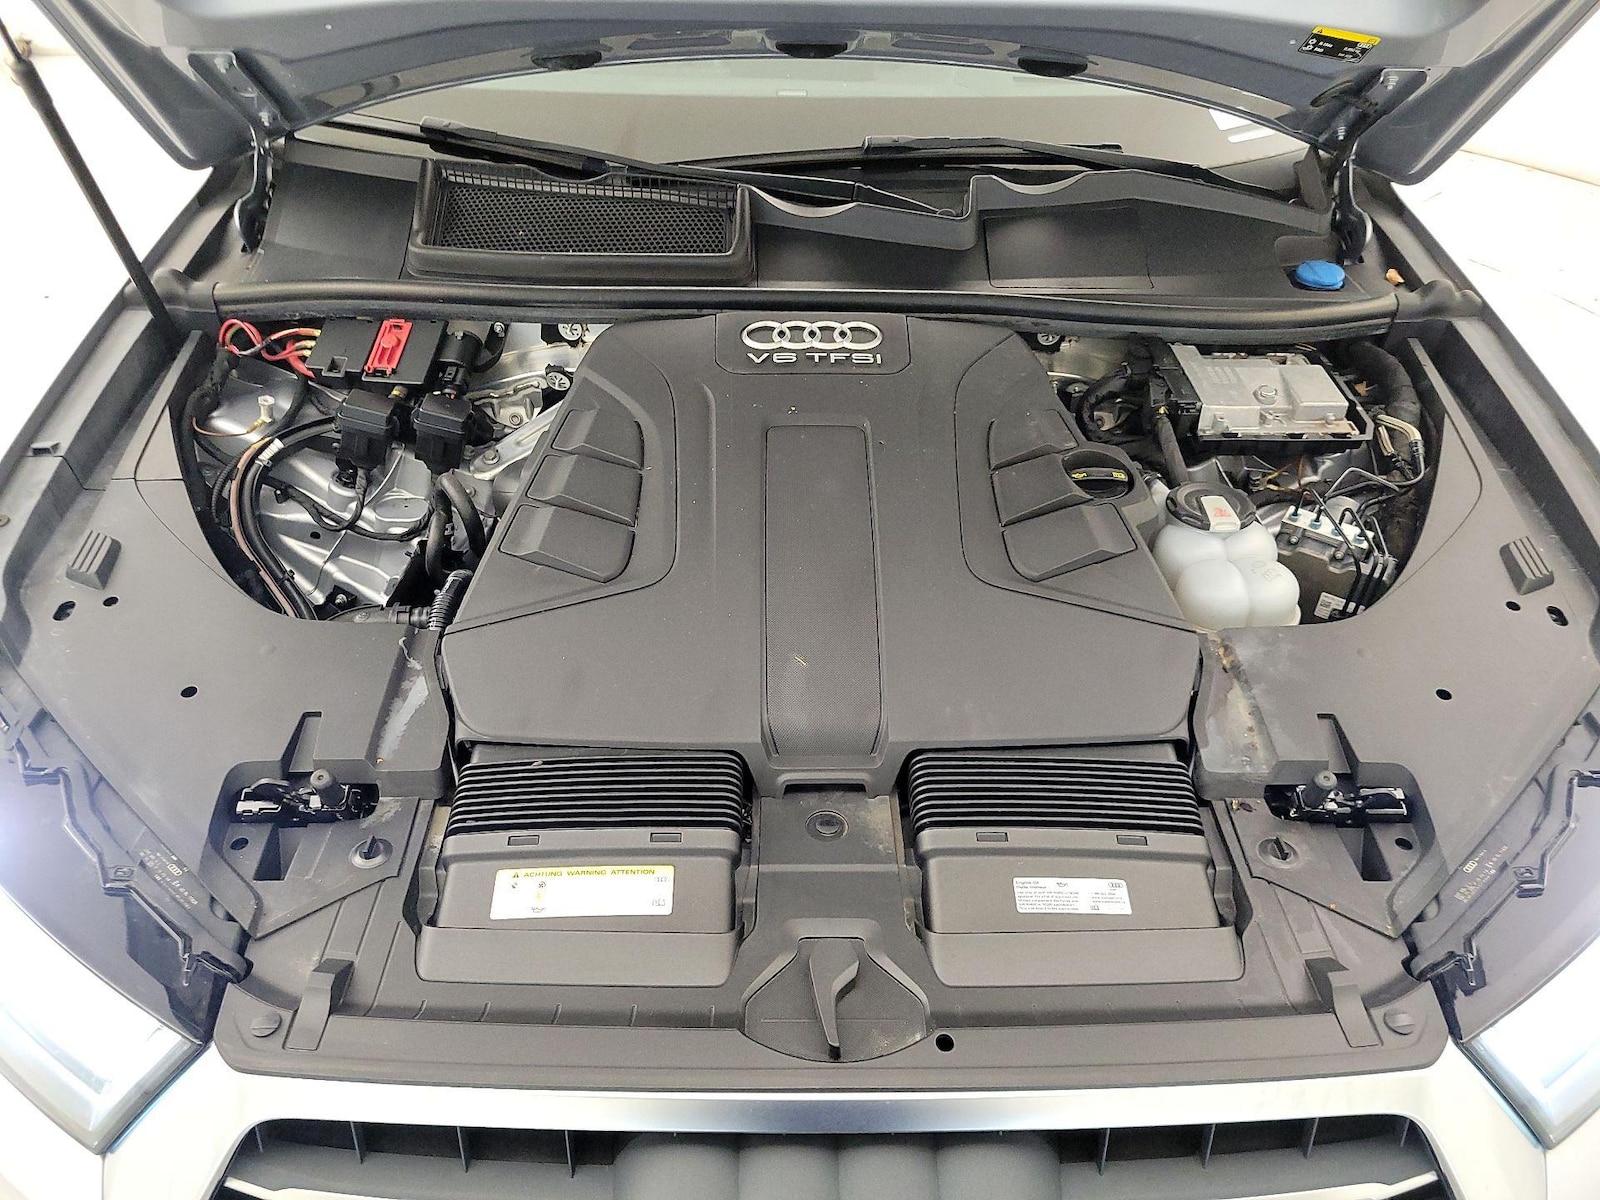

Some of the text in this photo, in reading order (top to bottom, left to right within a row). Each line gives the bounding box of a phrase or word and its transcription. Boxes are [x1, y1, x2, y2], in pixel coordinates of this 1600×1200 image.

[746, 352, 882, 364] V6 TFSI
[523, 868, 656, 878] ACHTUNG WARNING ATTENTION
